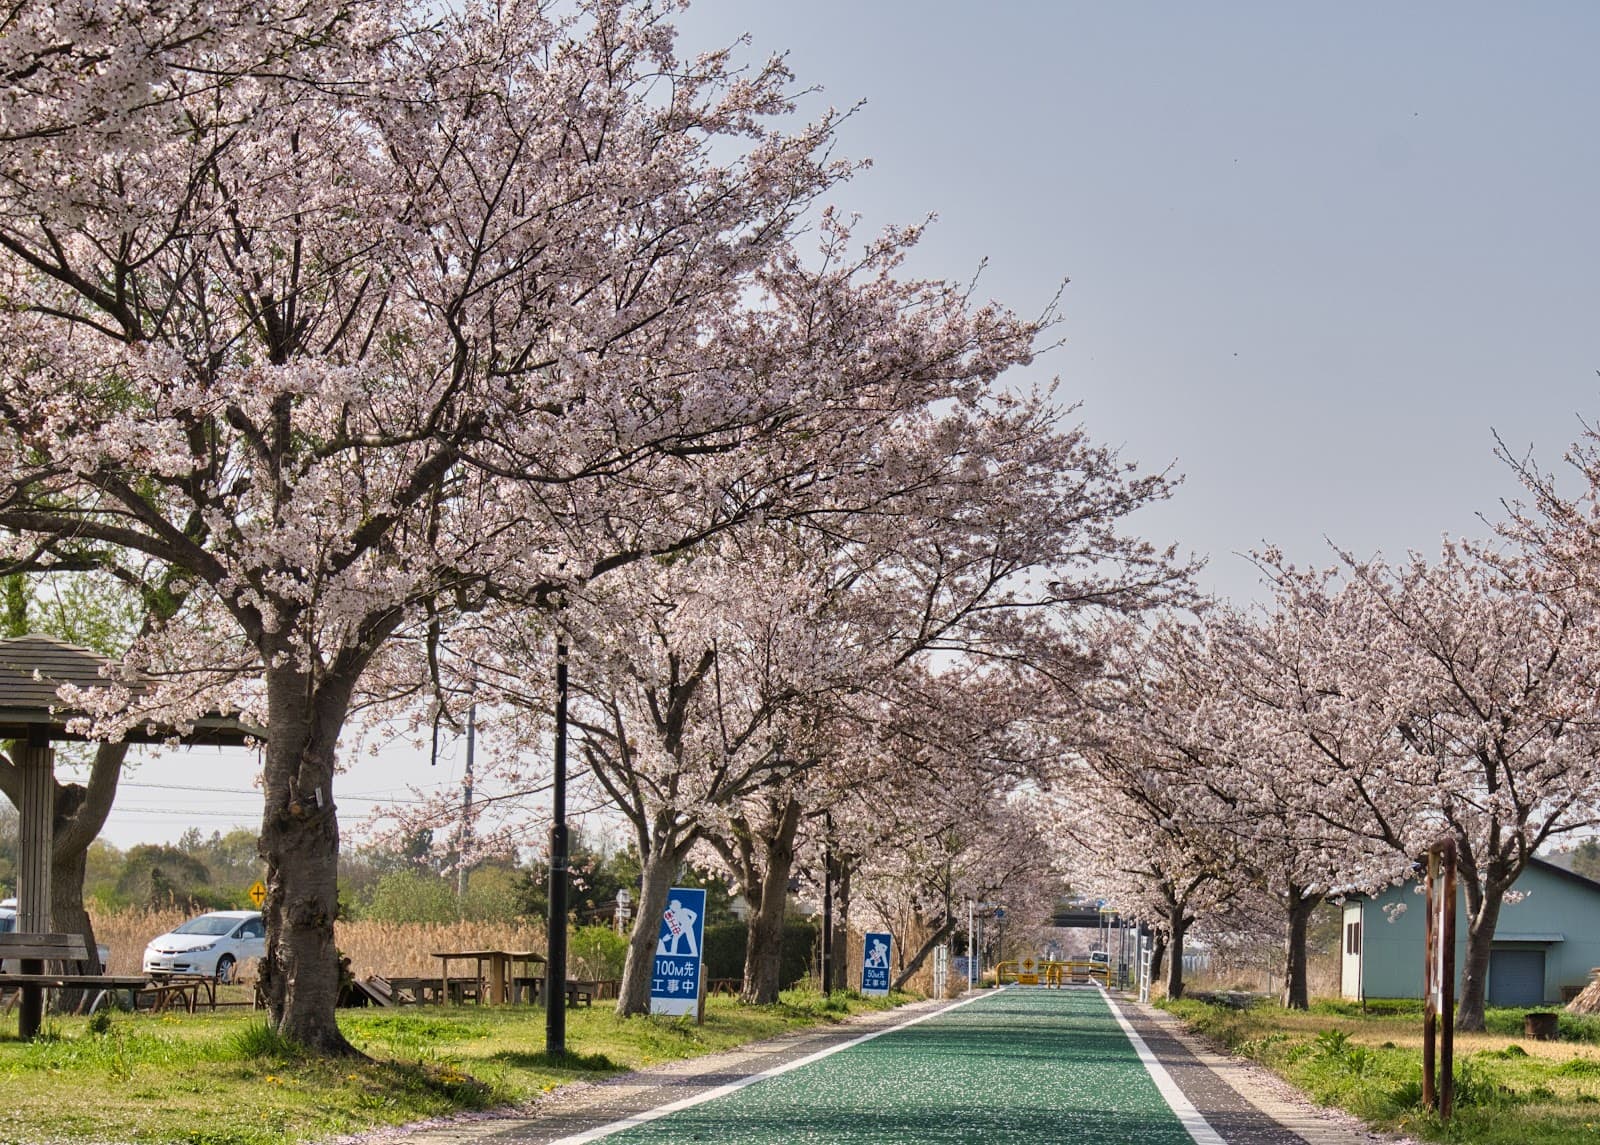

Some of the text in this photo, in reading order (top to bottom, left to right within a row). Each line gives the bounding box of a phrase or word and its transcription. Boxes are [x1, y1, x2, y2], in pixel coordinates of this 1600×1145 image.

[655, 960, 694, 976] 100M先
[652, 978, 694, 994] 工事中
